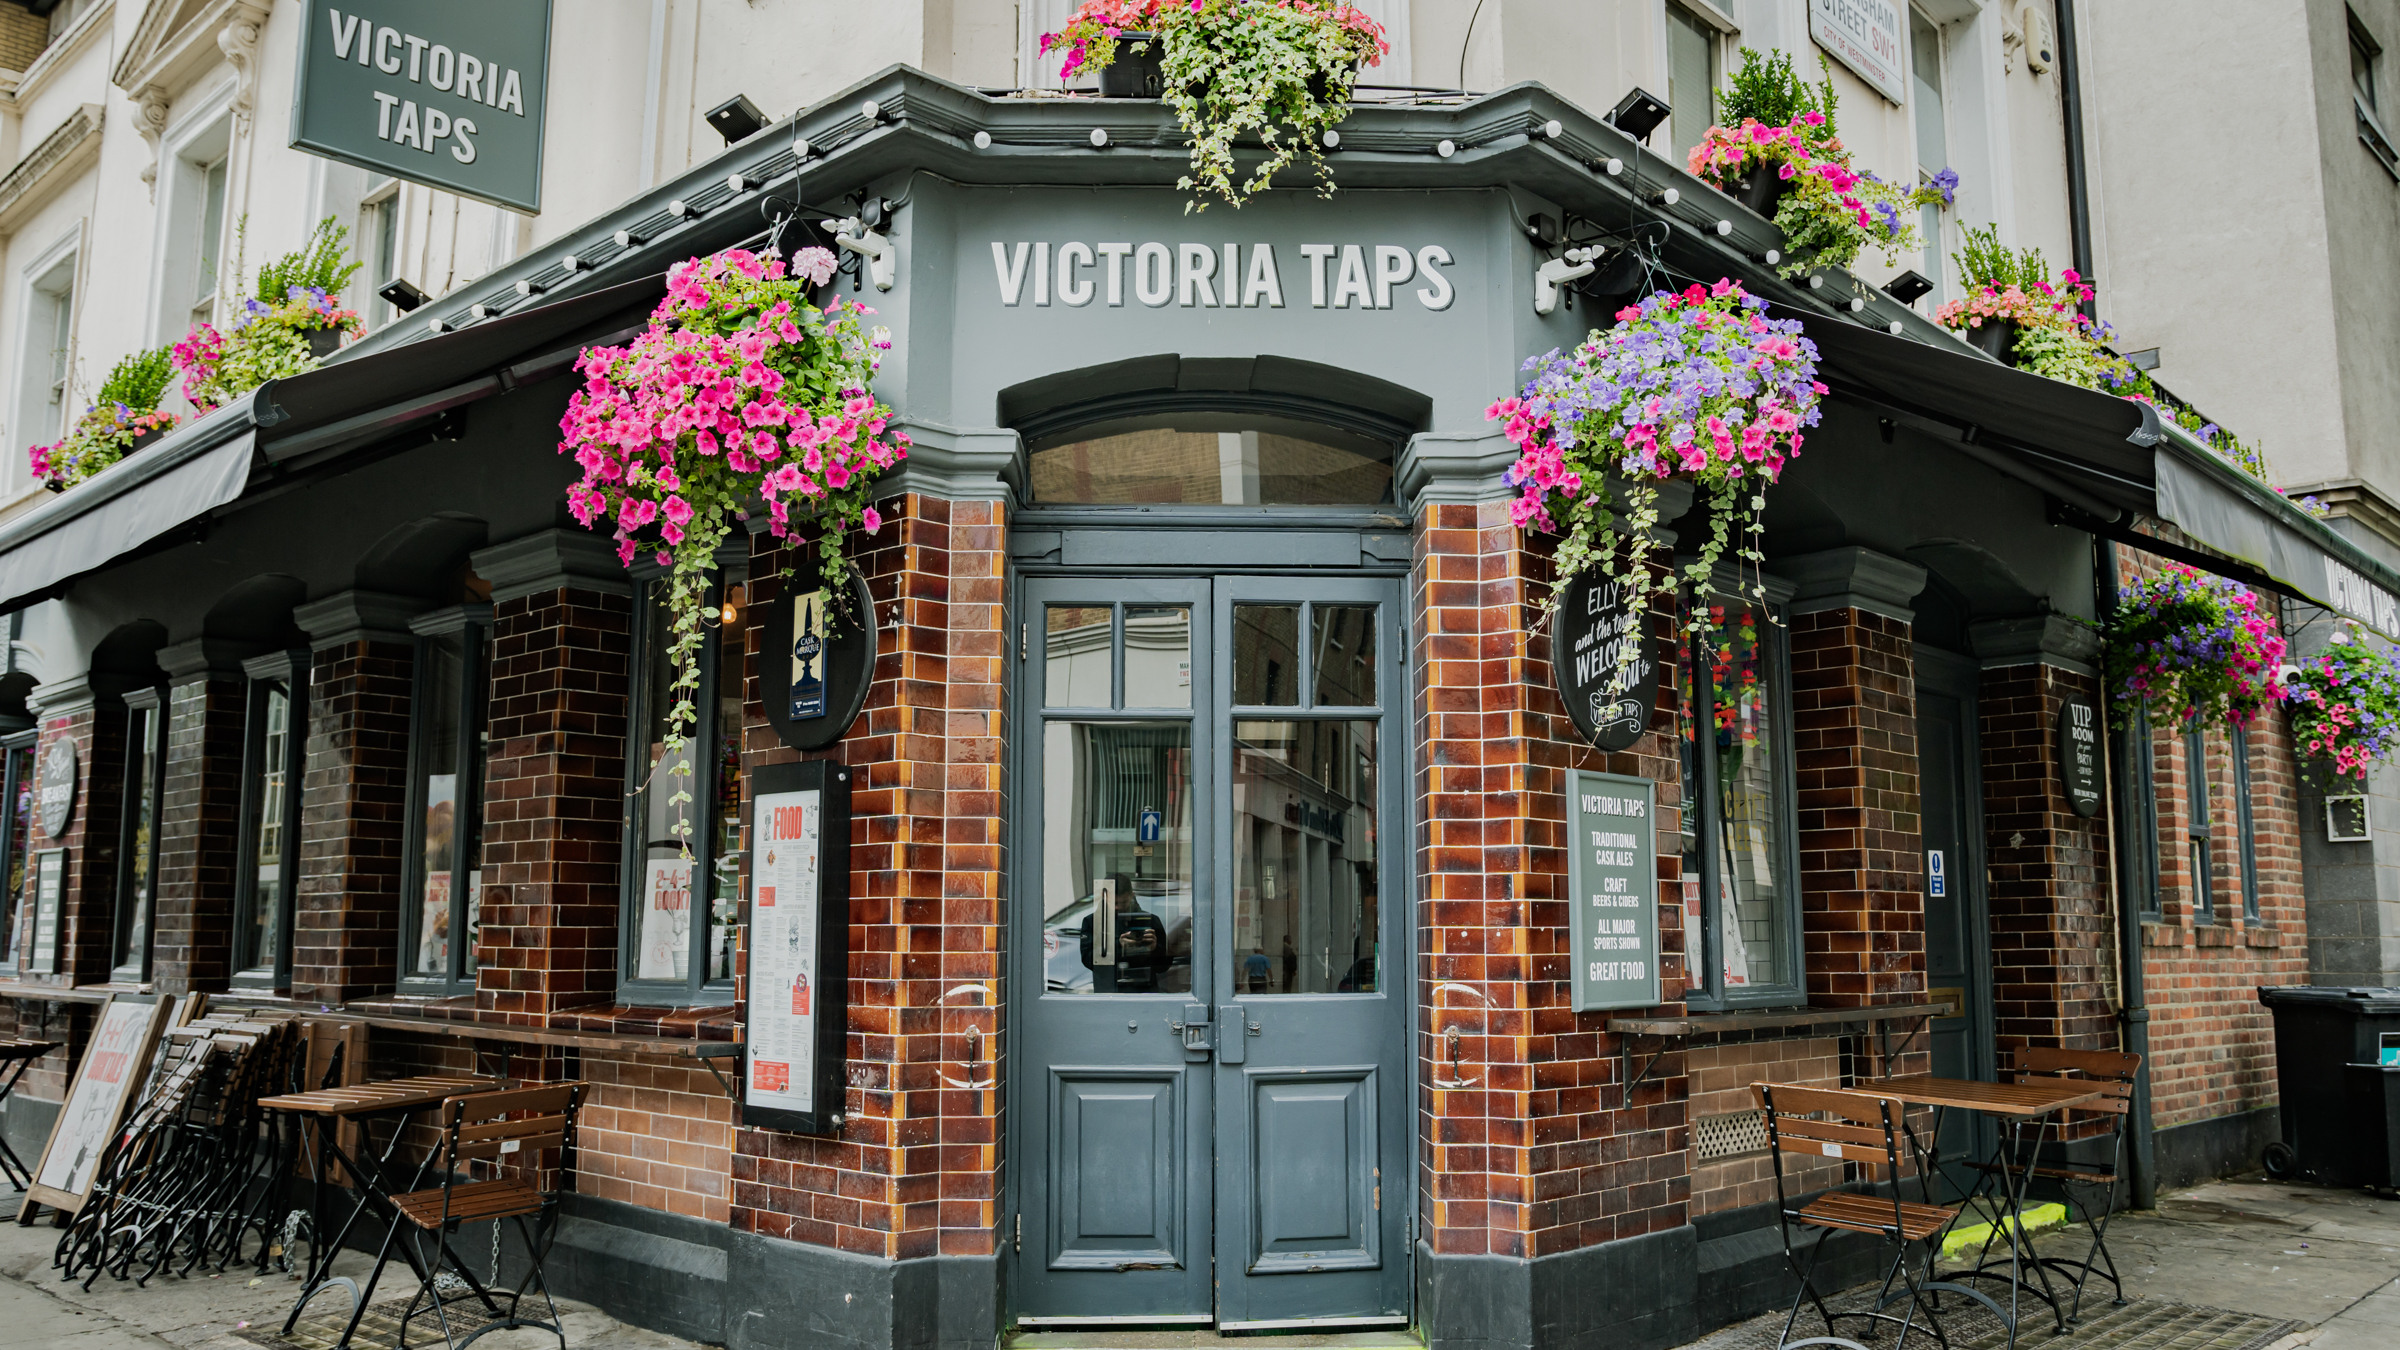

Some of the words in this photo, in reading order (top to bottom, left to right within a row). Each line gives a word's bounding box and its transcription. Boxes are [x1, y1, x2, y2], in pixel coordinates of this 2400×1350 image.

[1823, 26, 1837, 44] CITY
[1838, 37, 1846, 50] OF
[1847, 45, 1886, 84] WESTMINSTER
[1871, 26, 1896, 66] SW1
[329, 8, 526, 118] VICTORIA
[373, 90, 479, 165] TAPS
[991, 241, 1286, 309] VICTORIA
[1300, 244, 1456, 312] TAPS
[1587, 582, 1620, 616] ELLY
[2323, 555, 2374, 626] VICTORIA
[2371, 584, 2399, 638] TAPS
[800, 636, 815, 645] CASK
[1575, 623, 1595, 652] and
[1596, 616, 1613, 641] the
[796, 643, 820, 655] MARQUE
[1640, 659, 1652, 677] to
[1624, 703, 1639, 718] TAPS
[2072, 726, 2094, 743] ROOM
[2076, 753, 2092, 766] PARTY
[41, 783, 72, 805] BREAKFAST
[1581, 794, 1623, 816] VICTORIA
[1624, 799, 1645, 818] TAPS
[1725, 790, 1766, 821] CRAFT
[773, 806, 803, 840] FOOD
[1591, 831, 1637, 849] TRADITIONAL
[1726, 822, 1769, 854] BEERS
[1596, 850, 1615, 866] CASK
[1616, 851, 1633, 867] ALES
[1604, 877, 1627, 893] CRAFT
[1592, 895, 1611, 907] BEERS
[1612, 896, 1617, 907] &
[1618, 896, 1639, 907] CIDERS
[1598, 919, 1611, 934] ALL
[1612, 919, 1636, 934] MAJOR
[1594, 937, 1618, 950] SPORTS
[1618, 937, 1640, 950] SHOWN
[1590, 962, 1618, 981] GREAT
[1620, 961, 1645, 980] FOOD
[86, 1050, 129, 1084] COCKTAILS
